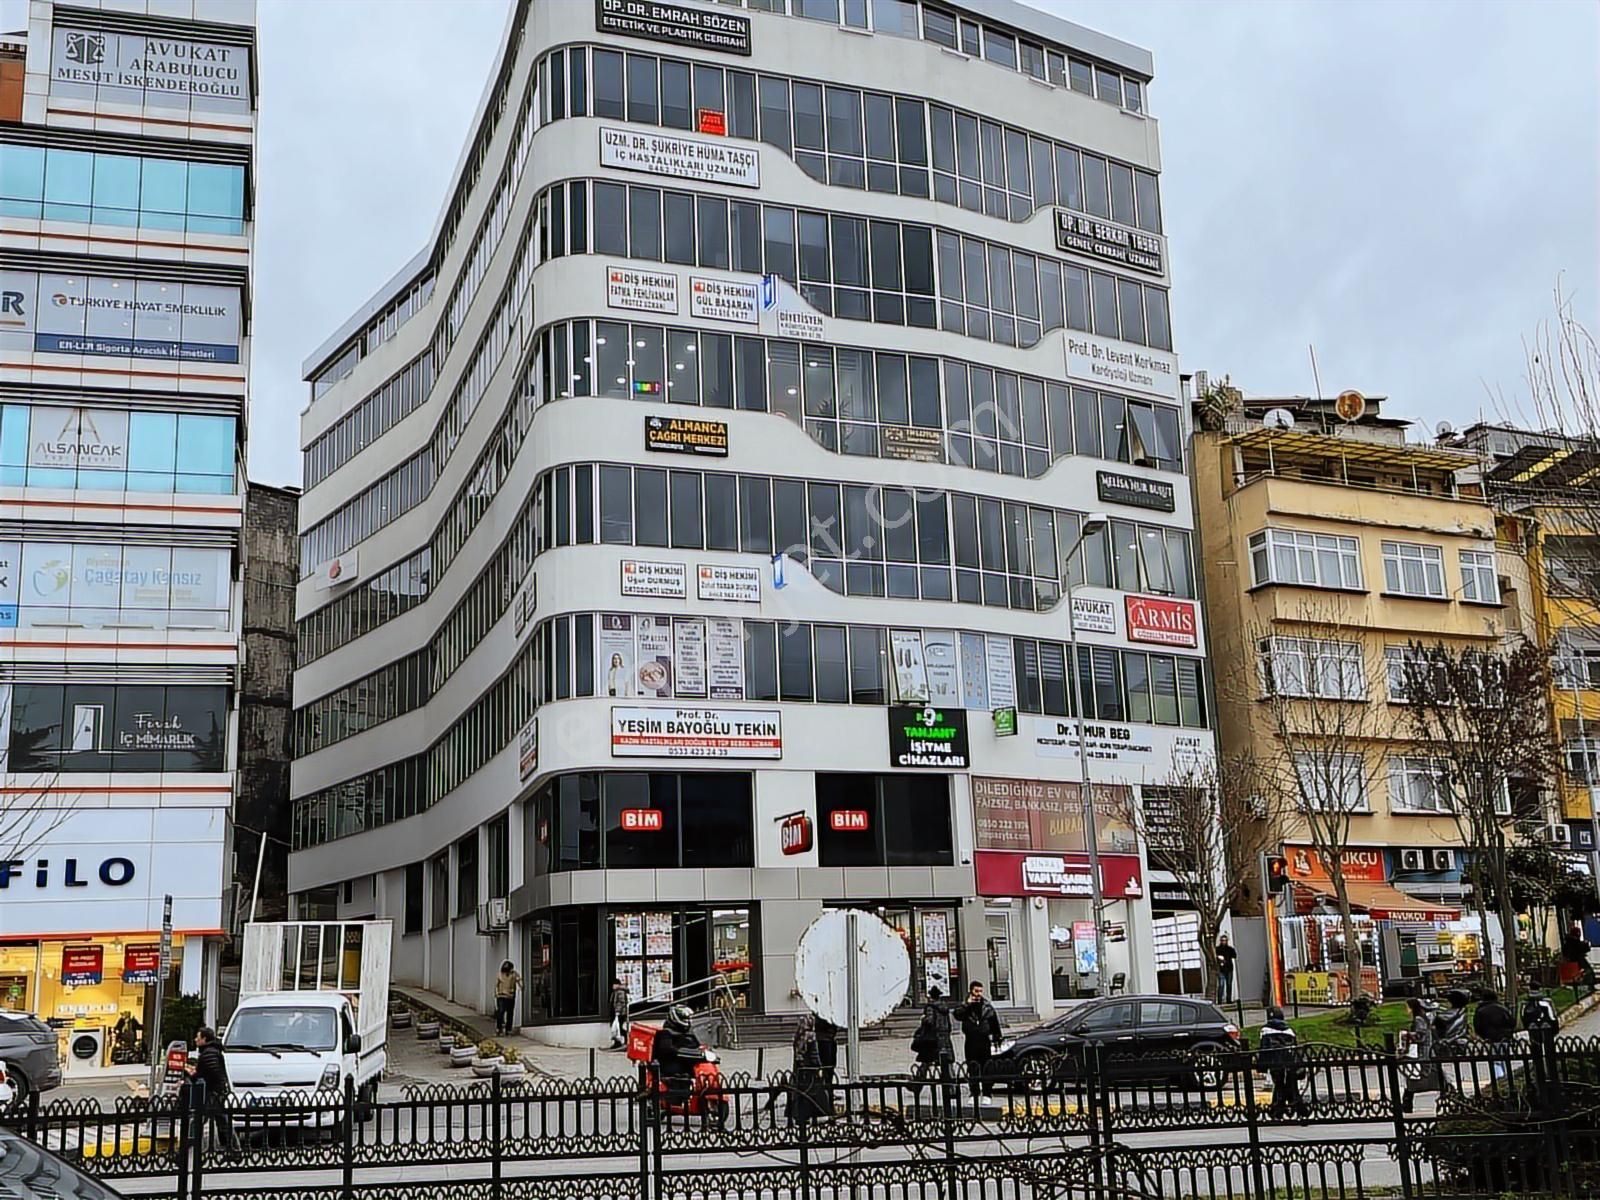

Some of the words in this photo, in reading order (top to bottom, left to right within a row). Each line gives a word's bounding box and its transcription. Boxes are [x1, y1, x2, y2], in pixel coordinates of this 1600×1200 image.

[627, 2, 650, 18] DR.
[652, 7, 700, 26] EMRAH
[702, 14, 746, 33] SÖZEN
[603, 16, 645, 31] ESTETİK
[647, 24, 660, 34] VE
[661, 25, 703, 41] PLASTİK
[704, 33, 747, 48] CERRAHİ
[144, 40, 231, 63] AVUKAT
[129, 58, 239, 80] ARABULUCU
[57, 66, 114, 84] MESUT
[118, 70, 241, 97] İSKENDEROĞLU
[605, 132, 630, 148] UZM.
[632, 137, 649, 151] DR.
[727, 152, 755, 169] TAŞÇI
[615, 148, 626, 160] İÇ
[629, 151, 704, 171] HASTALIKLARI
[706, 163, 747, 177] UZMANI
[1061, 214, 1077, 232] OP.
[1078, 218, 1094, 237] DR.
[1066, 236, 1092, 251] GENEL
[1094, 243, 1127, 262] CERRAHİ
[624, 272, 640, 287] DİŞ
[642, 275, 675, 289] HEKİMİ
[707, 281, 721, 295] DİŞ
[723, 285, 756, 300] HEKİMİ
[124, 299, 162, 313] HAYAT
[696, 294, 714, 307] GÜL
[715, 298, 754, 312] BAŞARAN
[96, 342, 131, 354] Sigorta
[169, 345, 216, 359] Hizmetleri
[1068, 338, 1091, 357] Prof.
[1092, 343, 1105, 361] Dr.
[1106, 346, 1134, 366] Levent
[1135, 351, 1172, 375] Korkmaz
[669, 419, 726, 434] ALMANCA
[35, 442, 122, 456] ALSANCAK
[638, 564, 652, 575] DİŞ
[654, 565, 683, 576] HEKİMİ
[714, 569, 728, 580] DİŞ
[729, 570, 758, 581] HEKİMİ
[647, 577, 681, 586] DURMUŞ
[1073, 599, 1110, 615] AVUKAT
[1133, 605, 1193, 631] ARMİS
[676, 710, 701, 720] Prof.
[704, 711, 719, 720] Dr.
[618, 717, 662, 737] YEŞİM
[666, 717, 731, 736] BAYOĞLU
[734, 720, 777, 736] TEKİN
[1056, 723, 1072, 736] Dr.
[1073, 724, 1106, 739] TMUR
[120, 731, 133, 748] İÇ
[135, 731, 195, 744] MİMARLIK
[910, 740, 952, 755] İŞİTME
[898, 752, 965, 767] CİHAZLARI
[975, 781, 1044, 799] DİLEDİĞİNİZ
[1047, 787, 1061, 799] EV
[1064, 789, 1077, 800] ve
[624, 809, 659, 828] BİM
[833, 809, 865, 828] BİM
[782, 817, 803, 850] BİM
[1027, 872, 1051, 885] YAPI
[1387, 910, 1427, 922] TAVUKÇU
